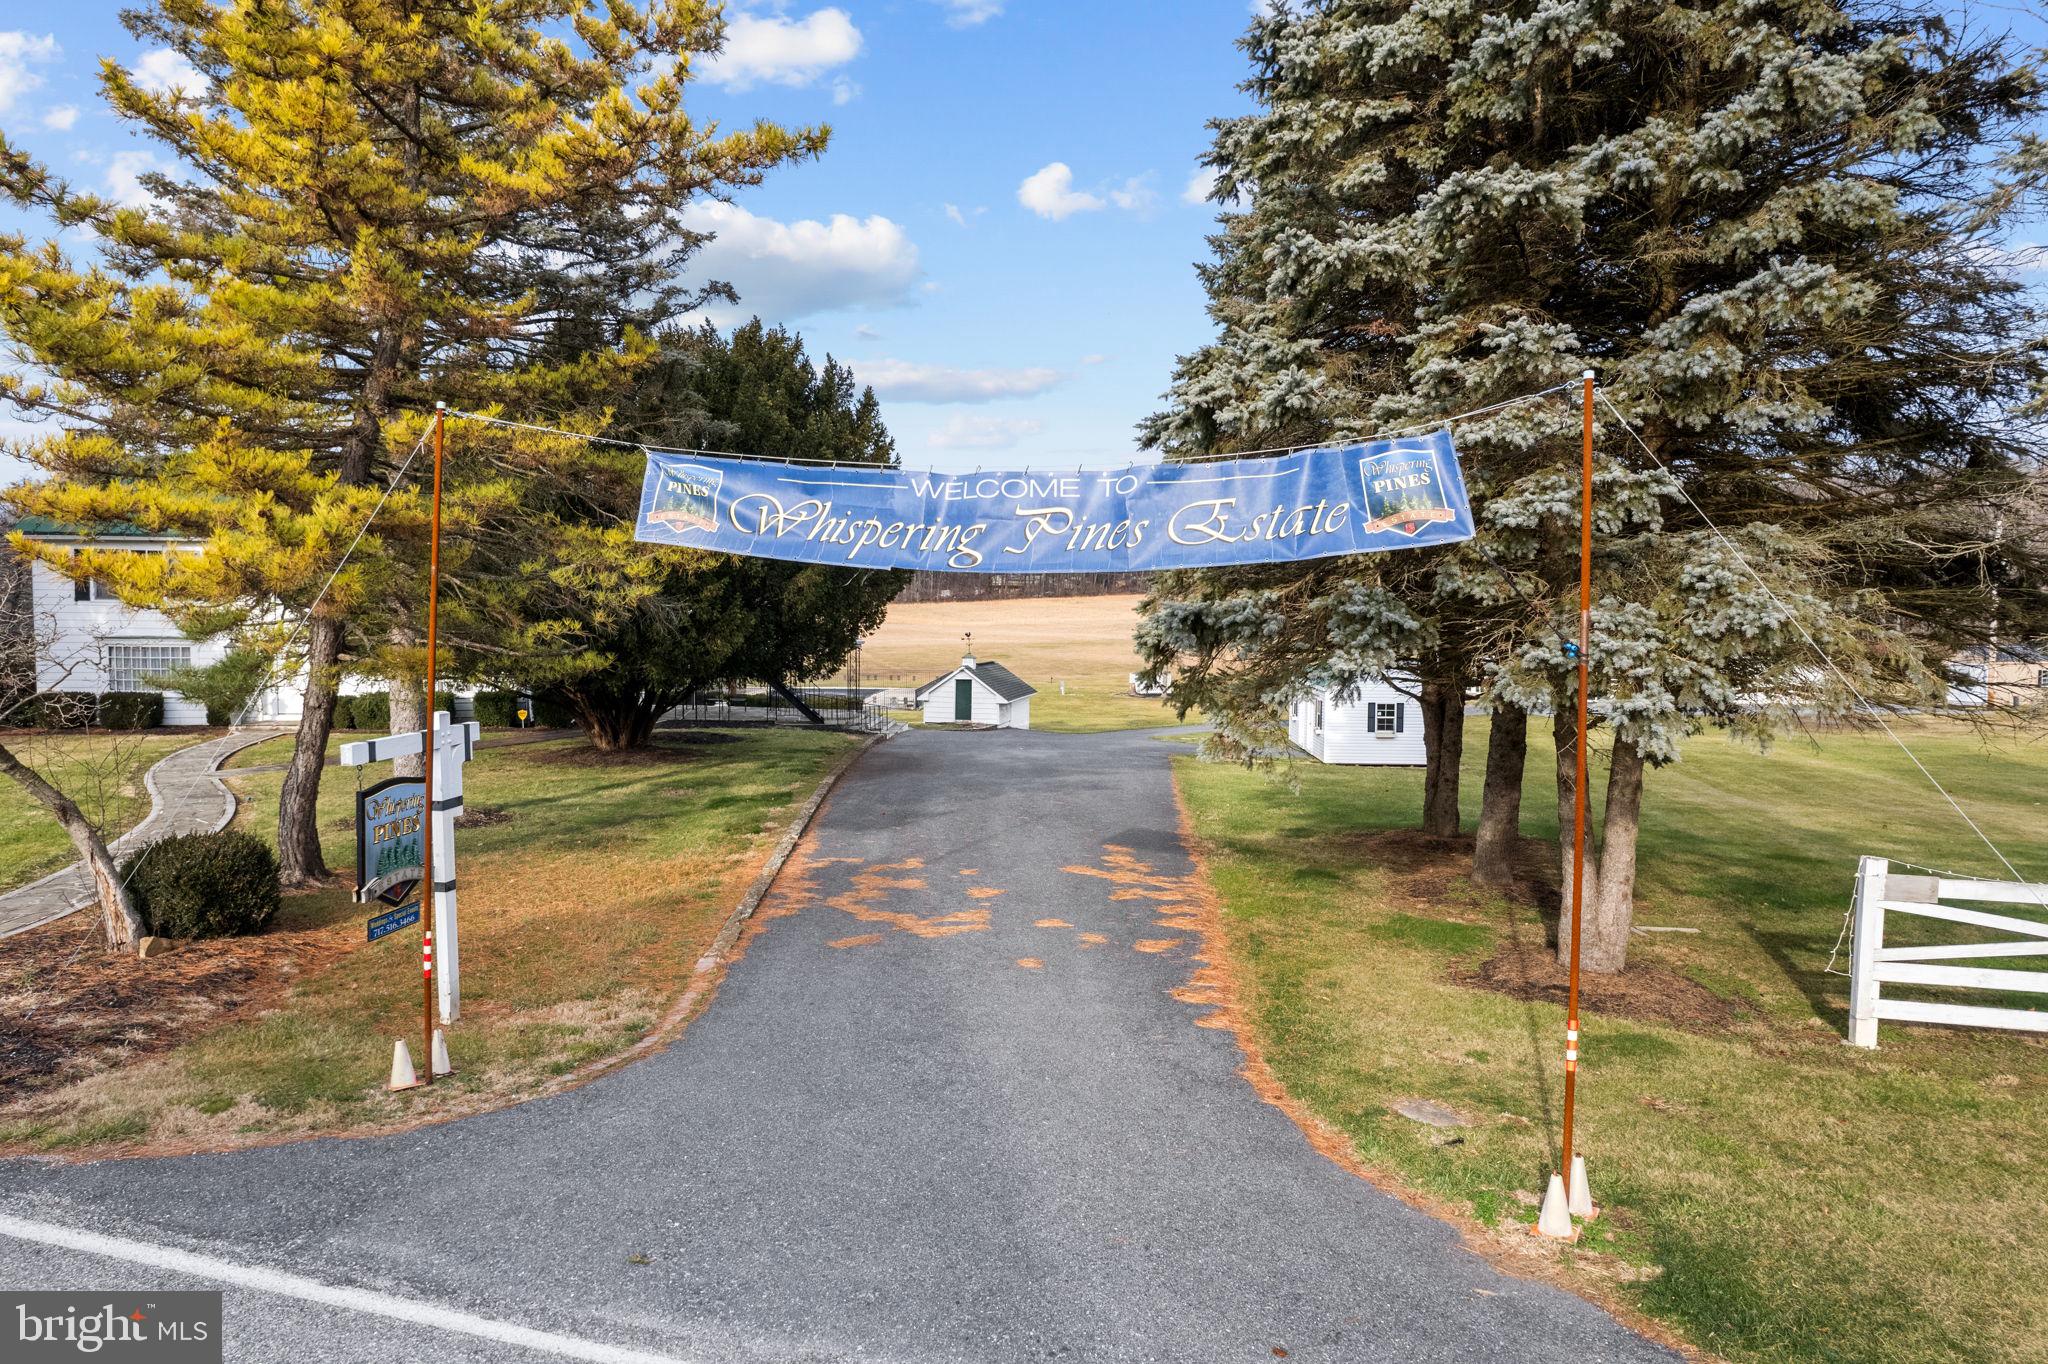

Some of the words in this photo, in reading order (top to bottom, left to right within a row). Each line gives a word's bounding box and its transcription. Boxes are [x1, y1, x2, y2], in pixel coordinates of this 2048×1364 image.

[1363, 459, 1433, 477] Whispering
[666, 481, 710, 497] PINES
[911, 476, 1081, 500] WELCOME
[1097, 475, 1138, 498] TO
[1373, 472, 1431, 493] PINES
[730, 493, 988, 569] Whispering
[1003, 504, 1150, 554] Pines
[1168, 498, 1350, 546] Estate
[373, 814, 421, 845] PINES
